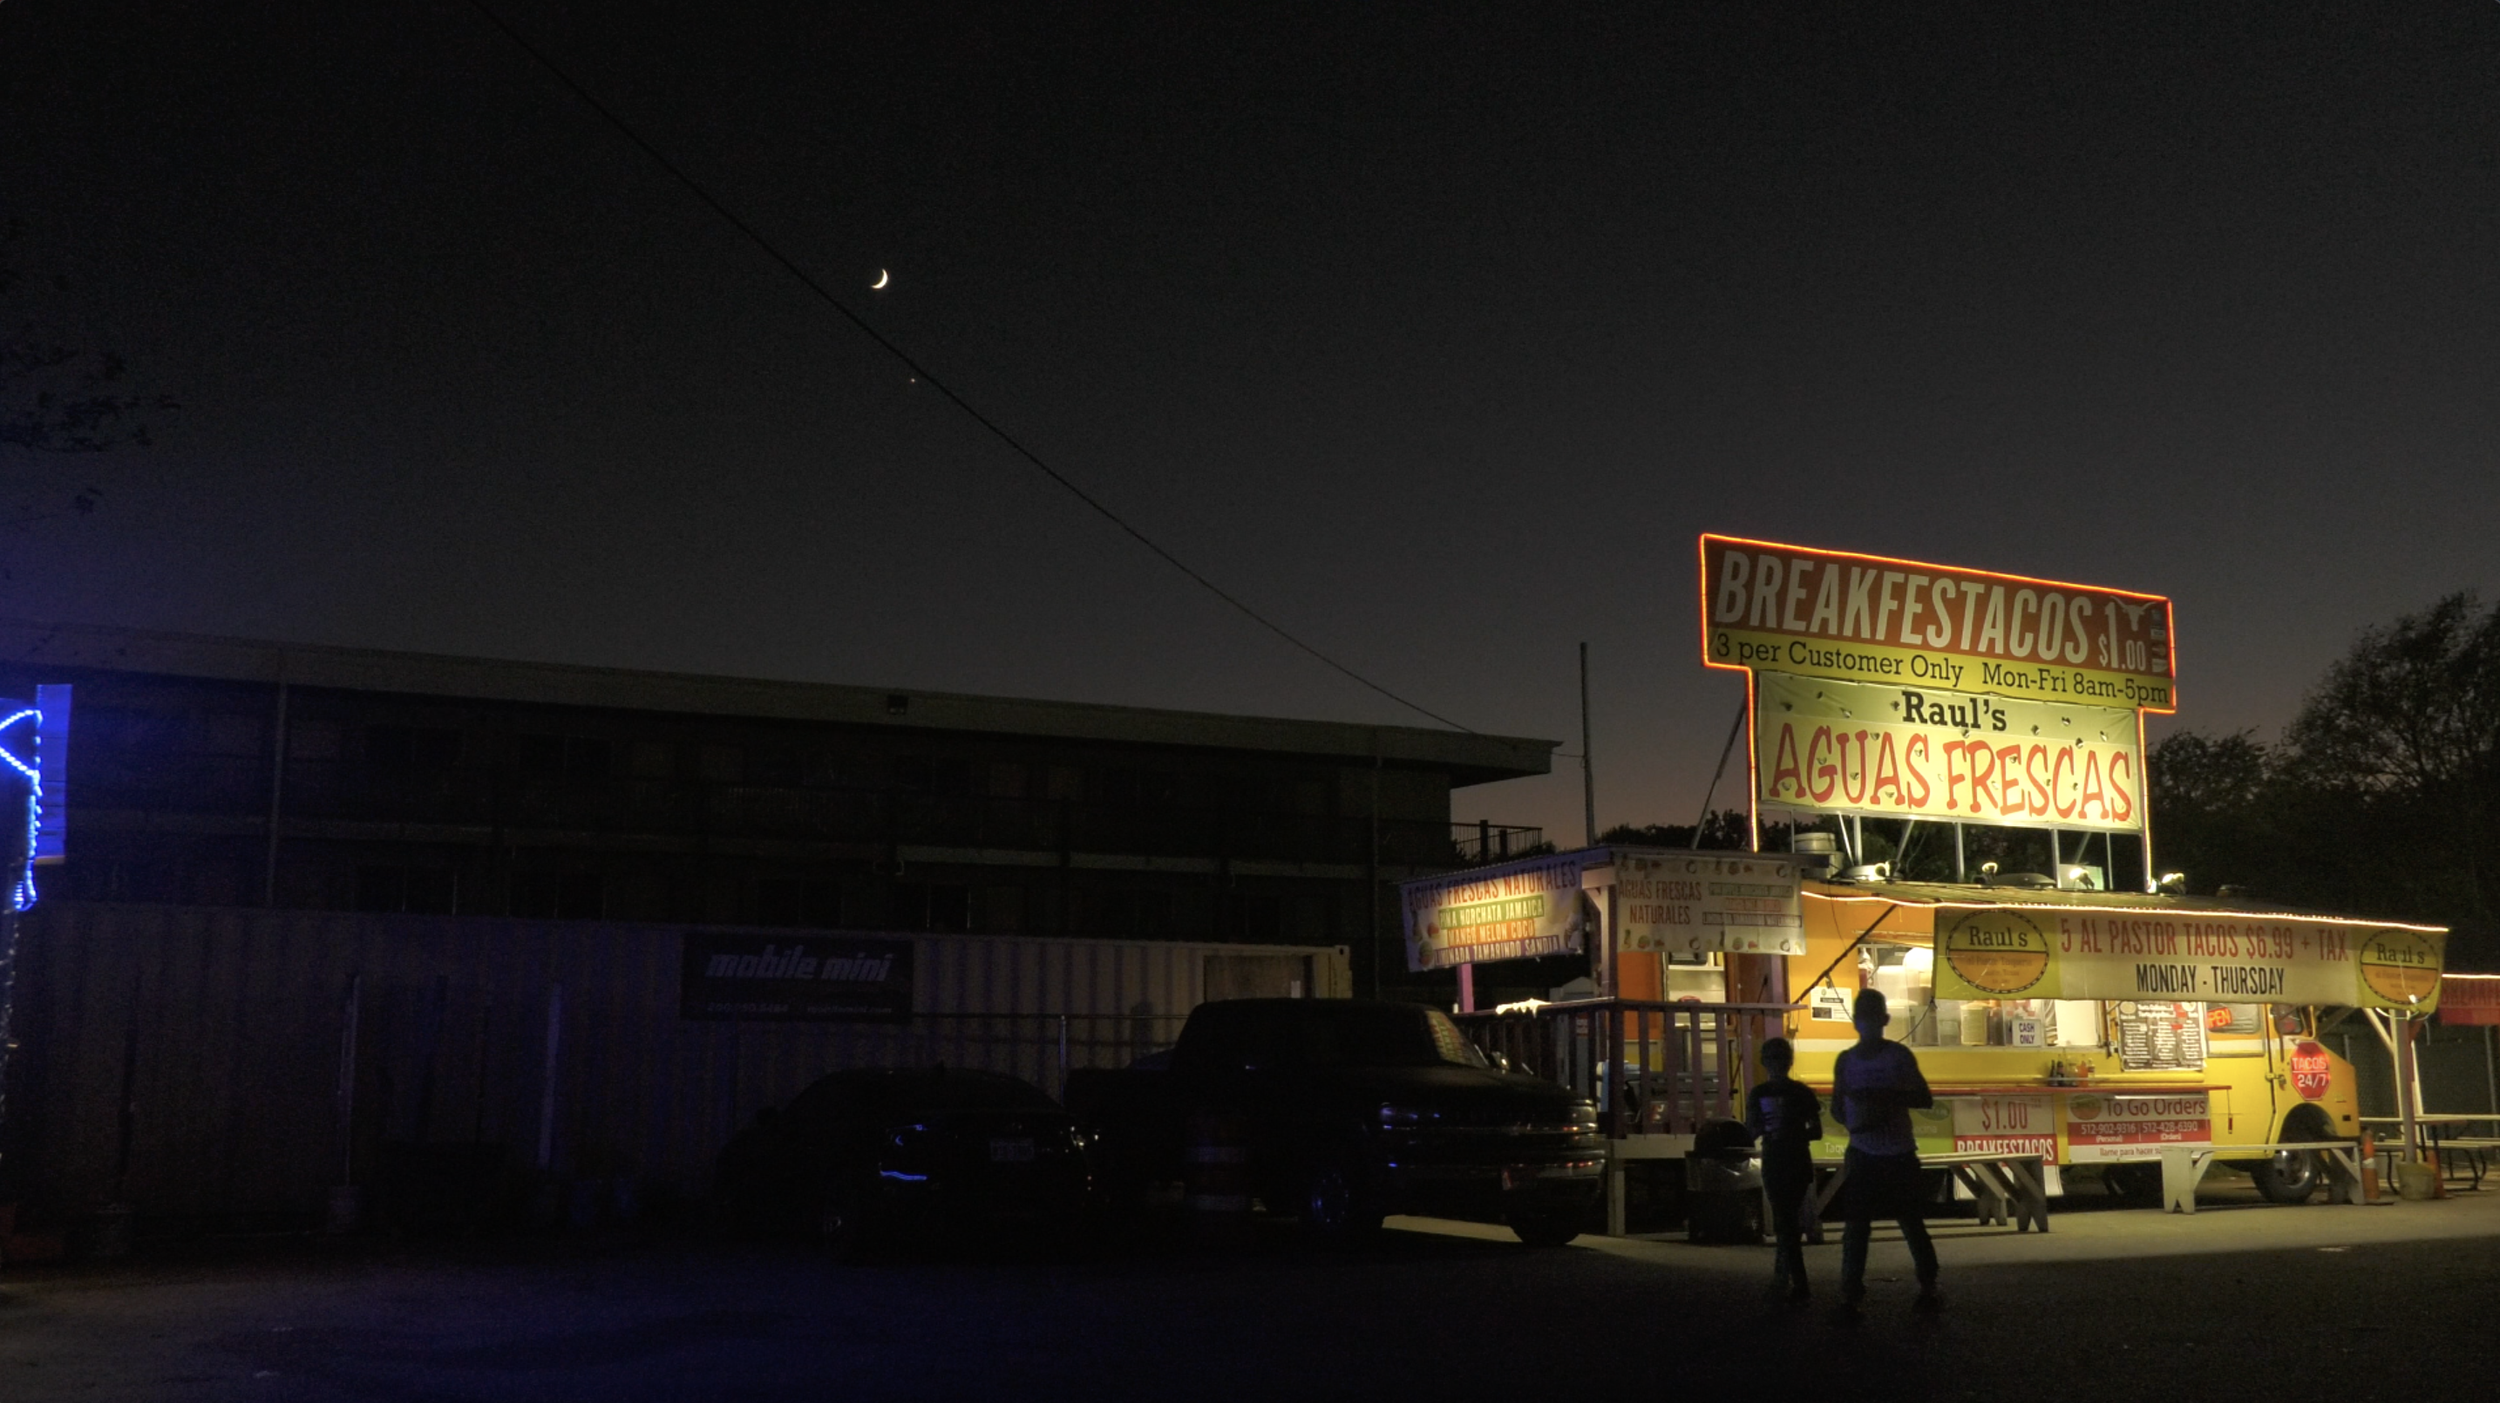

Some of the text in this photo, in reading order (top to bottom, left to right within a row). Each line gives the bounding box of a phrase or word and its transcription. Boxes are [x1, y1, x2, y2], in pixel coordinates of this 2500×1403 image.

[1716, 550, 2091, 664] BREAKFESTACOS
[2098, 601, 2146, 671] $1.00
[1717, 633, 2169, 707] 3 per Customer Only Mon-Fri 8am-5pm
[1902, 690, 2007, 732] Raul's
[1769, 722, 2132, 822] AGUAS FRESCAS
[1408, 861, 1577, 912] AGUAS FRESCAS NATURALES
[1620, 880, 1652, 899] AGUAS
[1656, 881, 1702, 901] FRESCAS
[1460, 904, 1502, 926] HORCHATA
[1505, 898, 1543, 919] JAMAICA
[1629, 904, 1690, 925] NATURALES
[1448, 919, 1535, 945] MANGO MELON COCO
[2060, 920, 2071, 952] 5
[2080, 920, 2102, 953] AL
[2109, 921, 2177, 955] PASTOR
[2183, 922, 2238, 957] TACOS
[2246, 923, 2294, 959] $6.99
[2318, 928, 2349, 961] TAX
[705, 944, 894, 981] mobile mini
[1473, 940, 1522, 962] TAMARINDO
[2136, 964, 2197, 993] MONDAY
[2211, 965, 2285, 995] THURSDAY
[2019, 1022, 2035, 1032] CASH
[2206, 1007, 2231, 1028] PEN
[2020, 1034, 2035, 1044] ONLY
[2291, 1057, 2327, 1070] TACOS
[2297, 1073, 2327, 1088] 24/7
[1982, 1101, 2028, 1131] $1.00
[2104, 1098, 2123, 1117] To
[2127, 1098, 2149, 1116] Go
[2154, 1097, 2206, 1115] Orders
[2081, 1122, 2136, 1135] 512-902-9316
